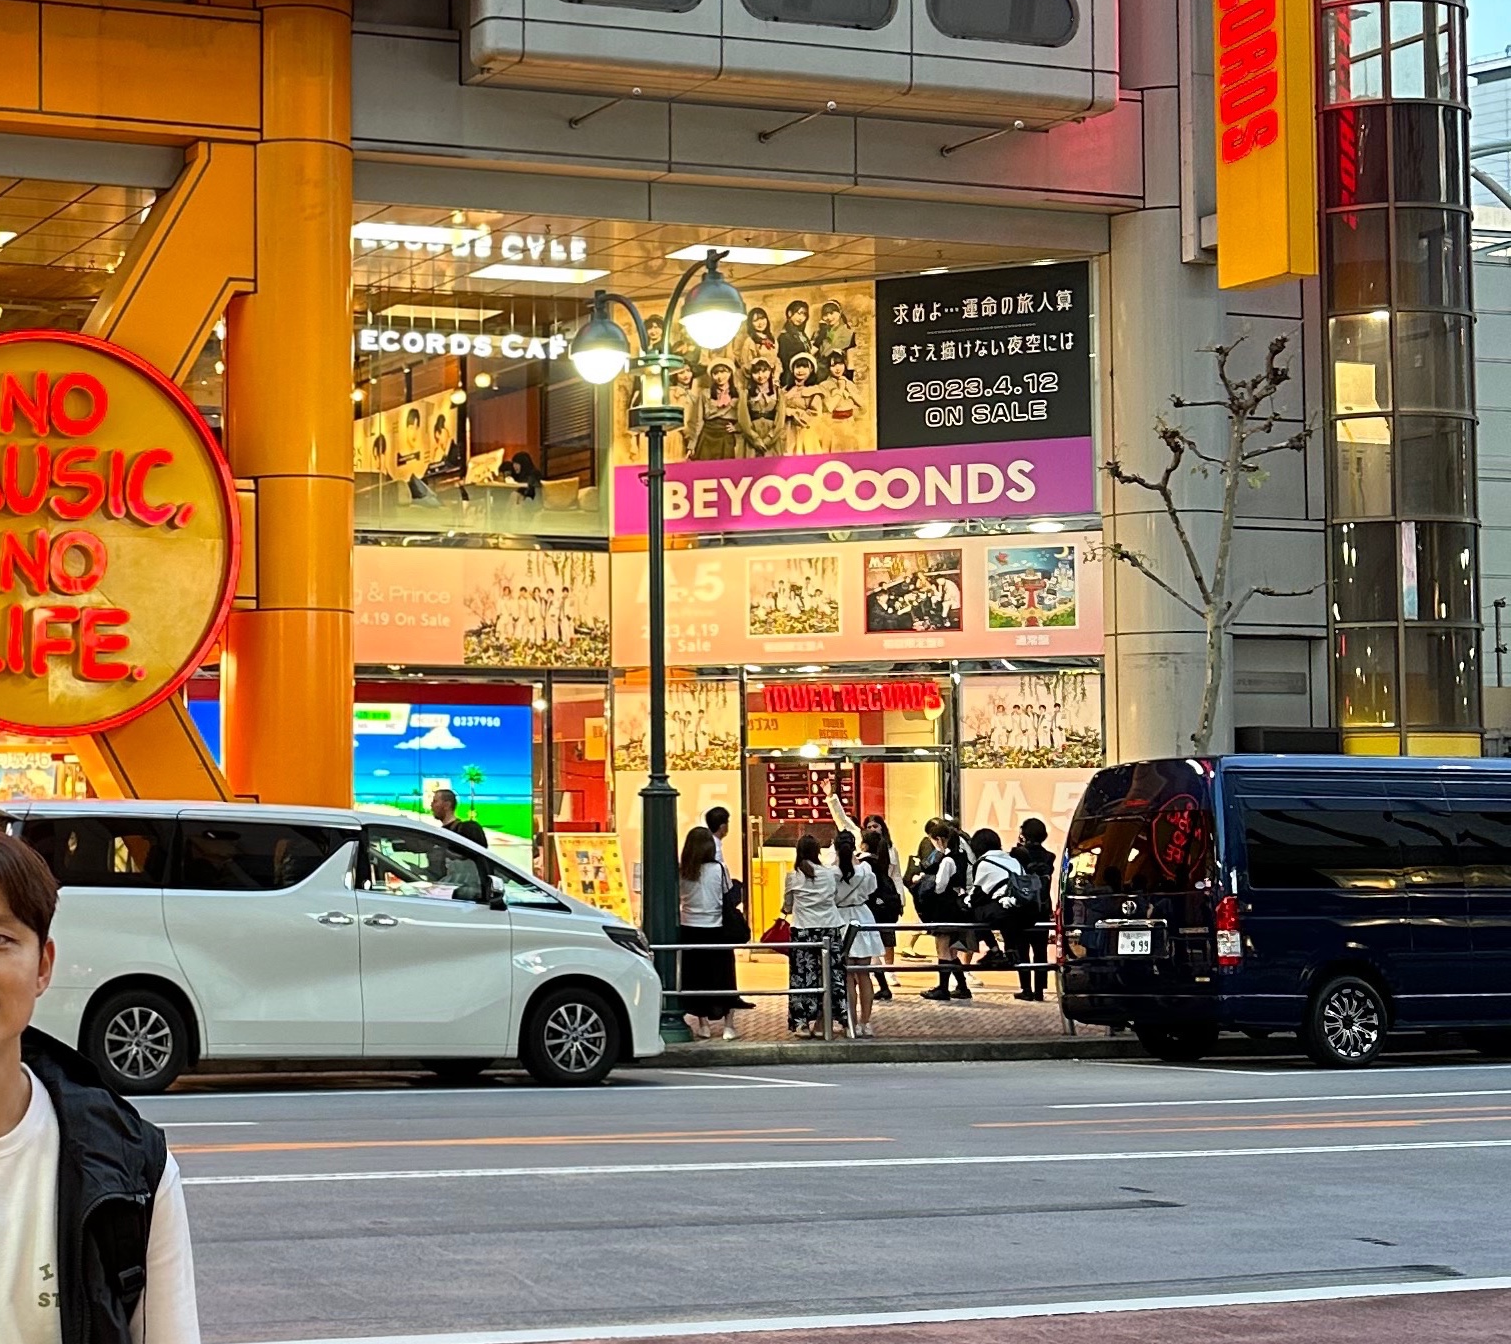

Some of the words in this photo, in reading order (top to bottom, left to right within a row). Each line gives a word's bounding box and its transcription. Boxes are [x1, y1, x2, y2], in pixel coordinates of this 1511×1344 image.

[359, 328, 493, 358] ECORDS
[500, 331, 570, 360] CAF
[891, 332, 1074, 364] 夢さえ描けない夜空には
[906, 371, 1059, 402] 2023.4.12
[0, 369, 109, 438] NO
[925, 405, 963, 427] ON
[971, 399, 1047, 424] SALE
[391, 585, 451, 604] Prince
[395, 612, 417, 626] On
[420, 612, 451, 627] Sale
[762, 683, 835, 713] TOWER
[840, 681, 942, 712] RECORDS
[38, 1262, 55, 1282] I
